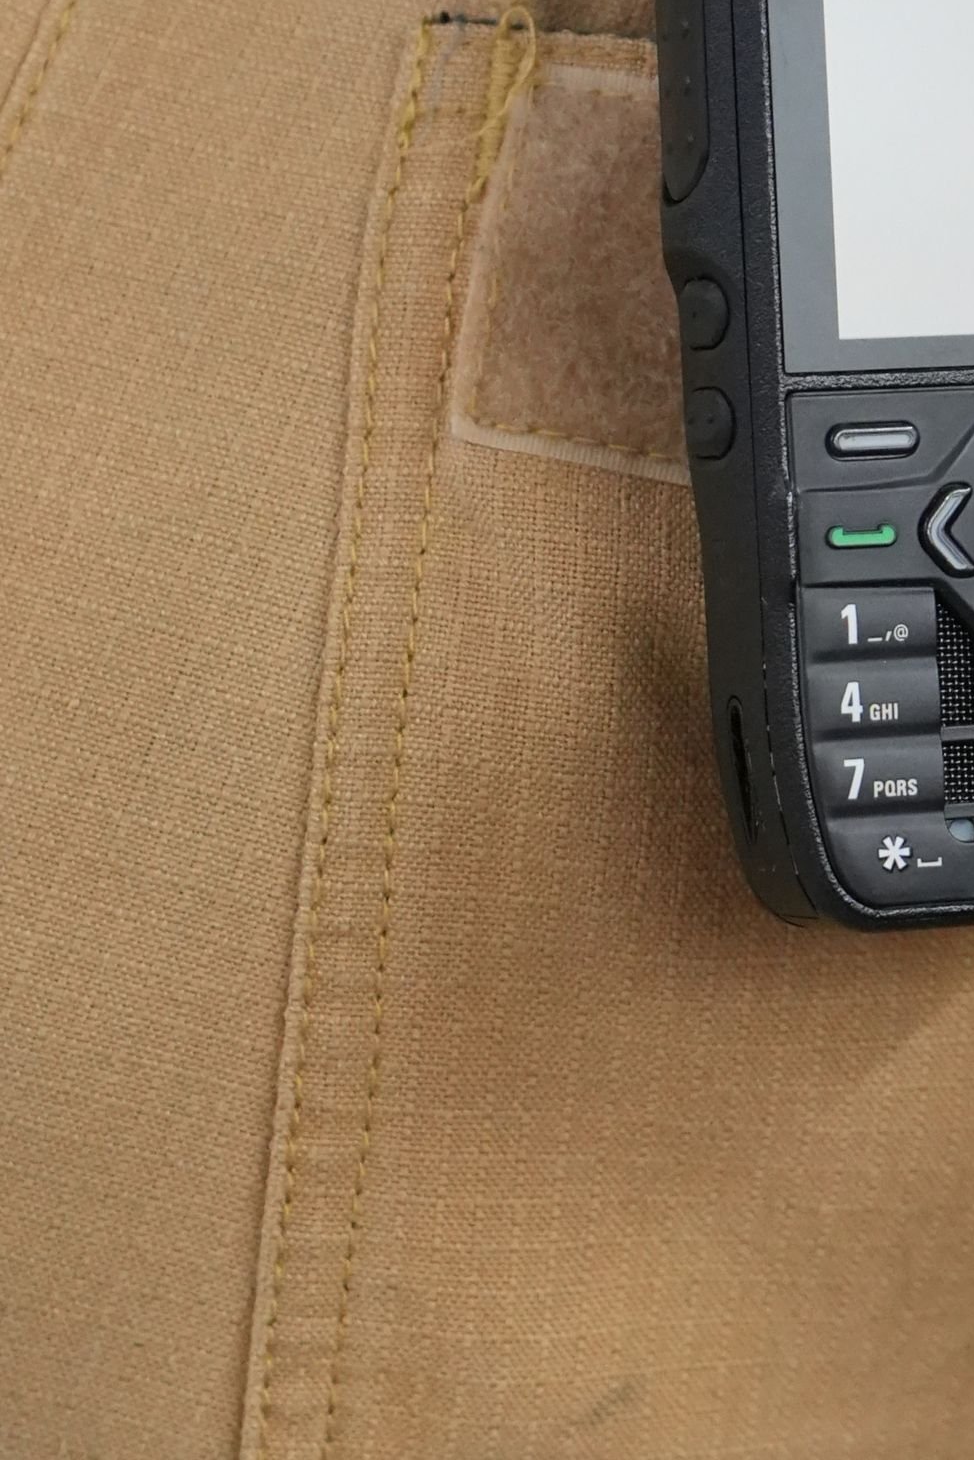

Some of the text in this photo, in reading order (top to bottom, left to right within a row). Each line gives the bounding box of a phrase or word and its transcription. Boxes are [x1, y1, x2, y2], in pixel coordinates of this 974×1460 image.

[841, 604, 858, 644] 1
[841, 682, 899, 722] 4 GHI
[843, 758, 918, 800] 7 PQRS
